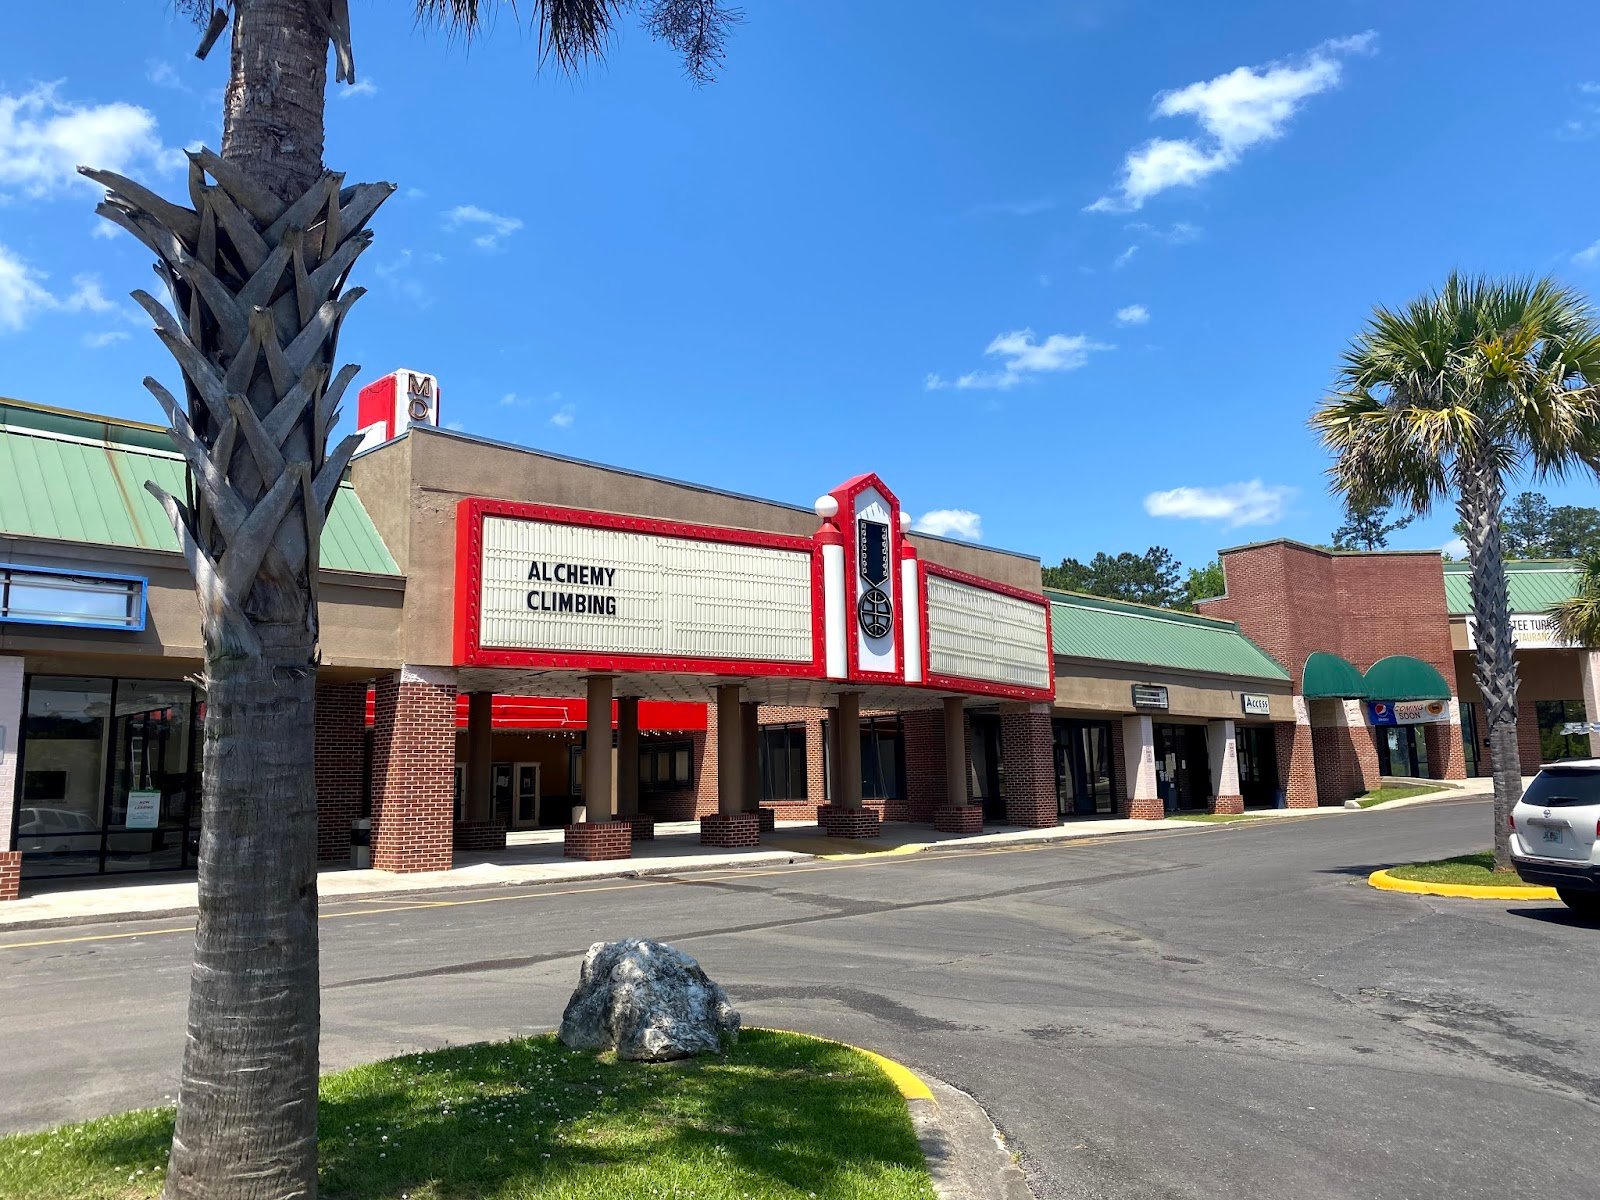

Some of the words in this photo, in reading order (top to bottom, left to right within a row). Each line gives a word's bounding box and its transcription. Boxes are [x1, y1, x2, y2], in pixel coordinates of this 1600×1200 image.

[527, 560, 615, 587] ALCHEMY
[527, 590, 616, 616] CLIMBING
[1510, 619, 1529, 631] TEE
[1512, 632, 1549, 643] STAURANT
[1394, 704, 1424, 712] COMING
[1399, 712, 1421, 720] SOON
